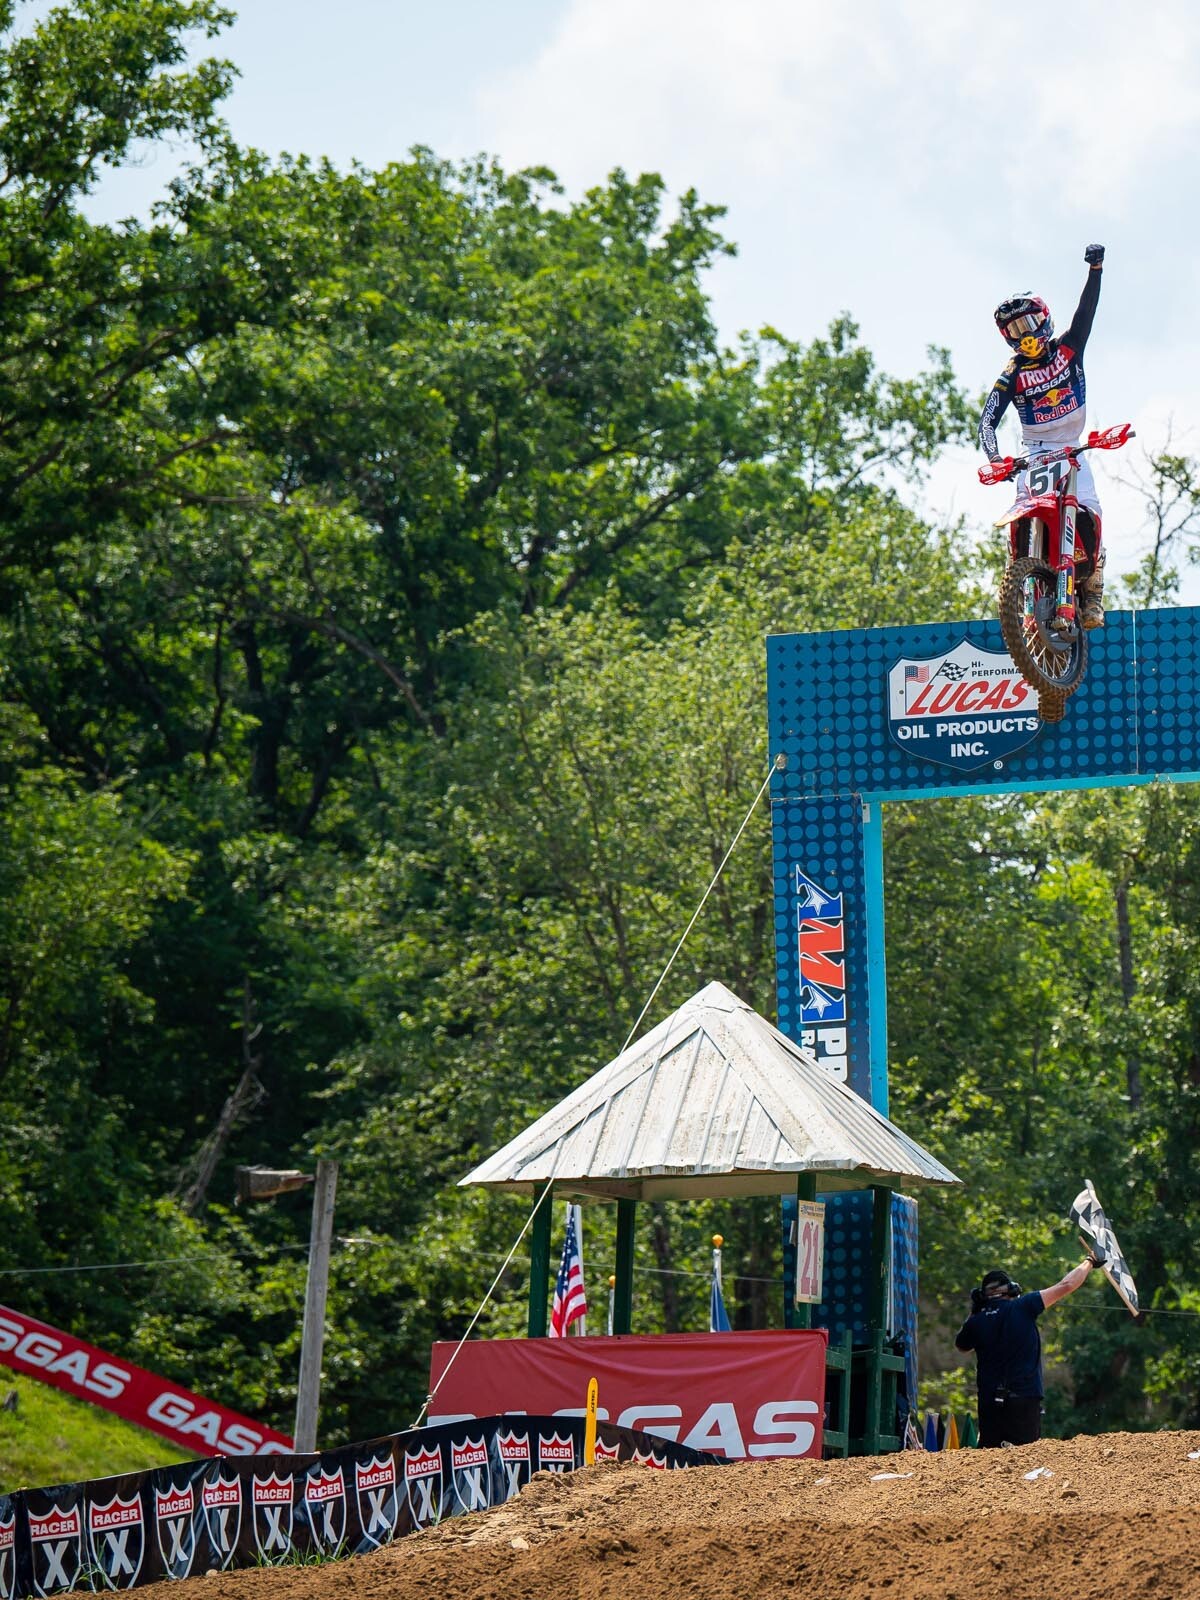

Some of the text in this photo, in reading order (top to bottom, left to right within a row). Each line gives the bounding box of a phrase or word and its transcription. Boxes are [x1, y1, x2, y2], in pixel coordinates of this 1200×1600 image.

[1019, 367, 1051, 388] TROY
[1049, 350, 1070, 376] LEE
[1025, 367, 1071, 396] GASGAS
[1033, 407, 1059, 423] Red
[1058, 396, 1079, 417] Bull
[1029, 462, 1062, 497] 51
[971, 668, 1020, 677] PERFORMA
[905, 679, 1033, 715] LUCAS
[897, 717, 1039, 740] OIL PRODUCTS
[951, 742, 989, 757] INC.
[817, 1027, 848, 1083] PR
[455, 1450, 485, 1465] RACER
[541, 1447, 571, 1458] RACER
[358, 1469, 392, 1487] RACER
[407, 1459, 439, 1475] RACER
[255, 1488, 290, 1500] RACER
[463, 1467, 488, 1510] X
[505, 1463, 521, 1500] X
[159, 1498, 191, 1515] RACER
[205, 1490, 237, 1503] RACER
[368, 1488, 392, 1533] X
[416, 1477, 436, 1521] X
[31, 1519, 75, 1536] RACER
[94, 1508, 139, 1526] RACER
[264, 1507, 286, 1550] X
[105, 1529, 134, 1578] X
[167, 1518, 189, 1564] X
[42, 1541, 70, 1589] X
